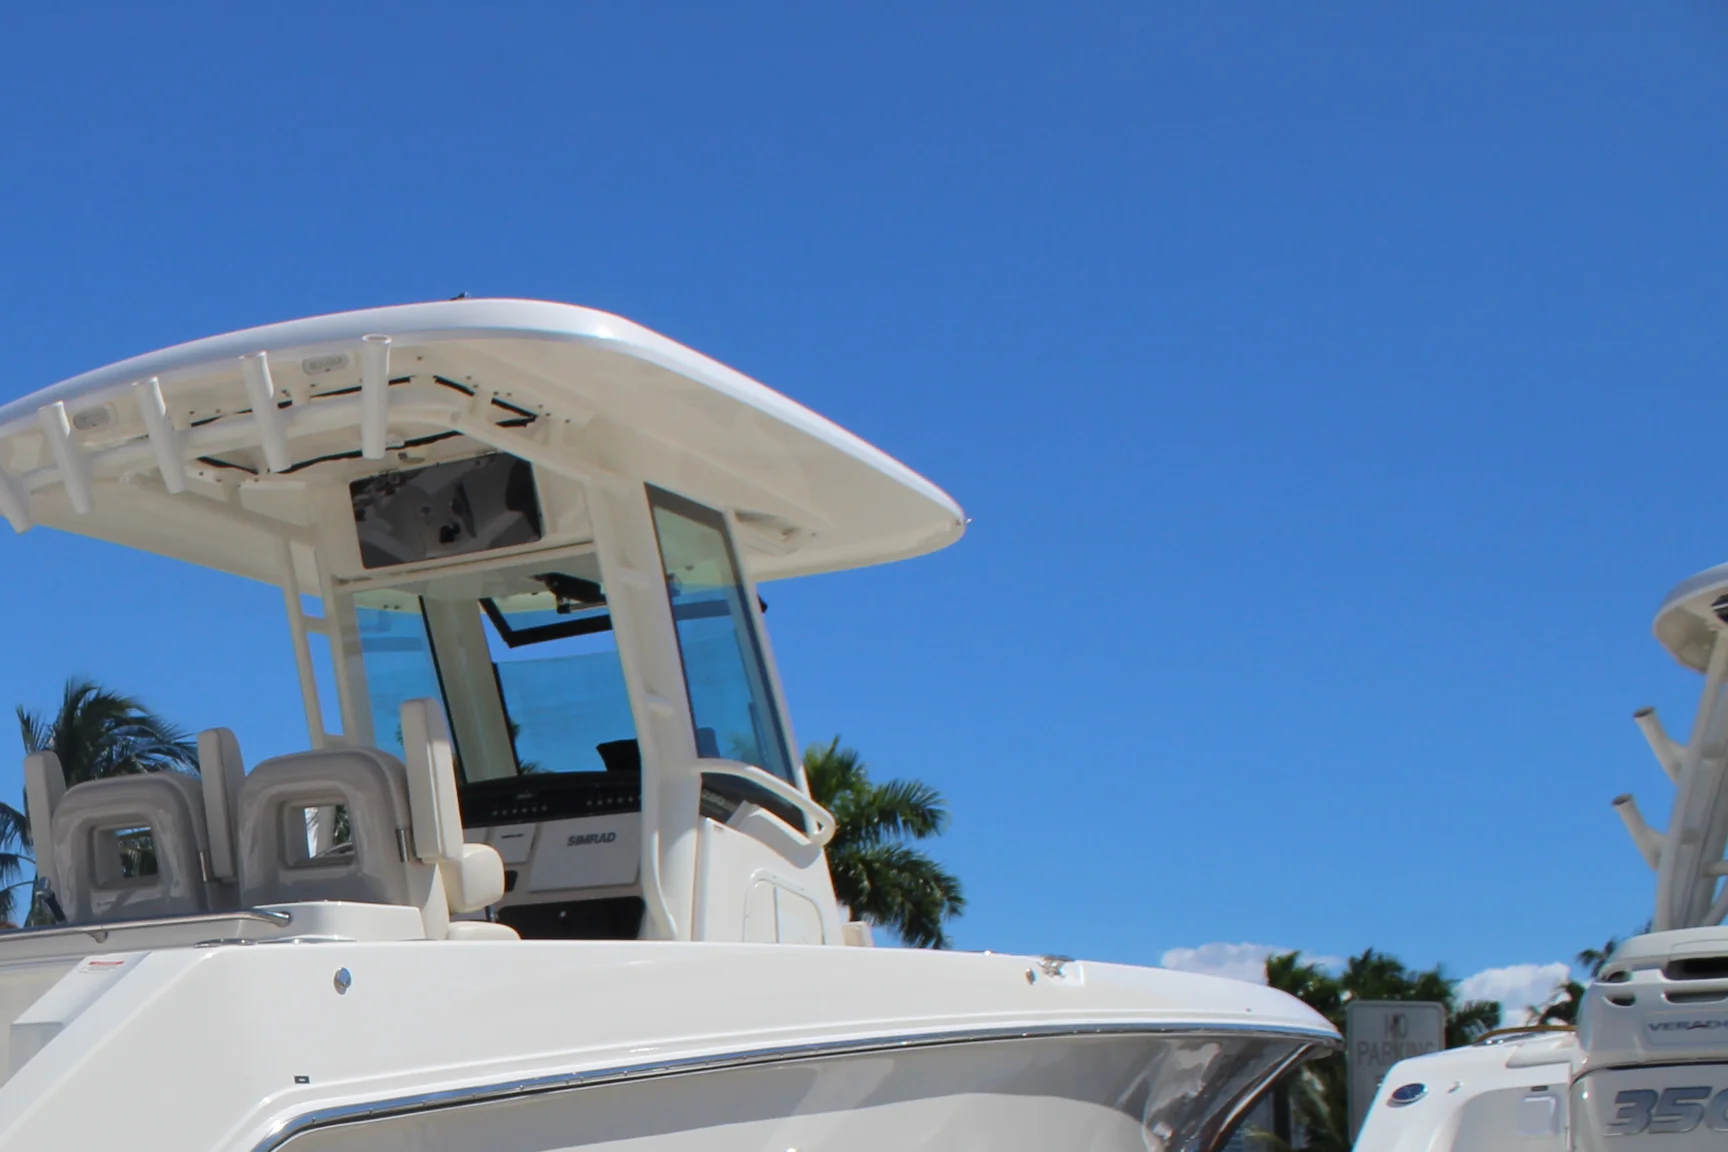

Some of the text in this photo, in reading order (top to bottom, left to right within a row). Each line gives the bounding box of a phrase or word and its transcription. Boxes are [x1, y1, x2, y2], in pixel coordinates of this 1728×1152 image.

[566, 831, 618, 847] SIMRAD
[1384, 1012, 1409, 1039] NO
[1648, 1019, 1728, 1032] VERAD
